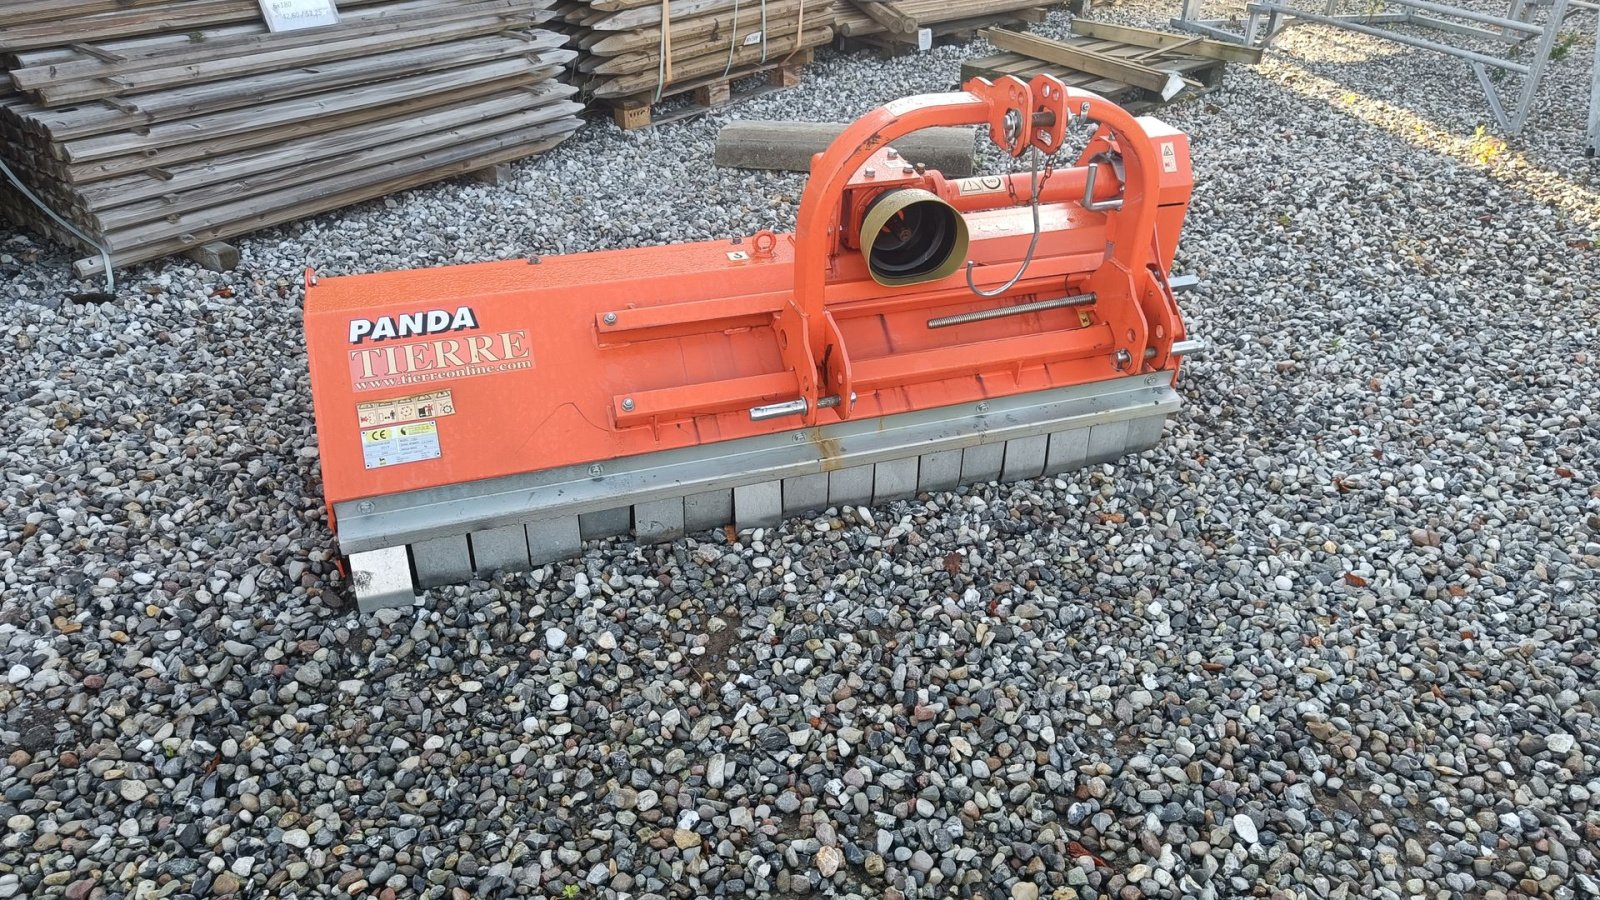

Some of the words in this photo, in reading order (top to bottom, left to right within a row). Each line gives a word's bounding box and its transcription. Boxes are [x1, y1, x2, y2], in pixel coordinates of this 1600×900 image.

[349, 306, 479, 344] PANDA
[351, 330, 530, 380] TIERRE
[355, 360, 531, 390] www.tierreonline.com
